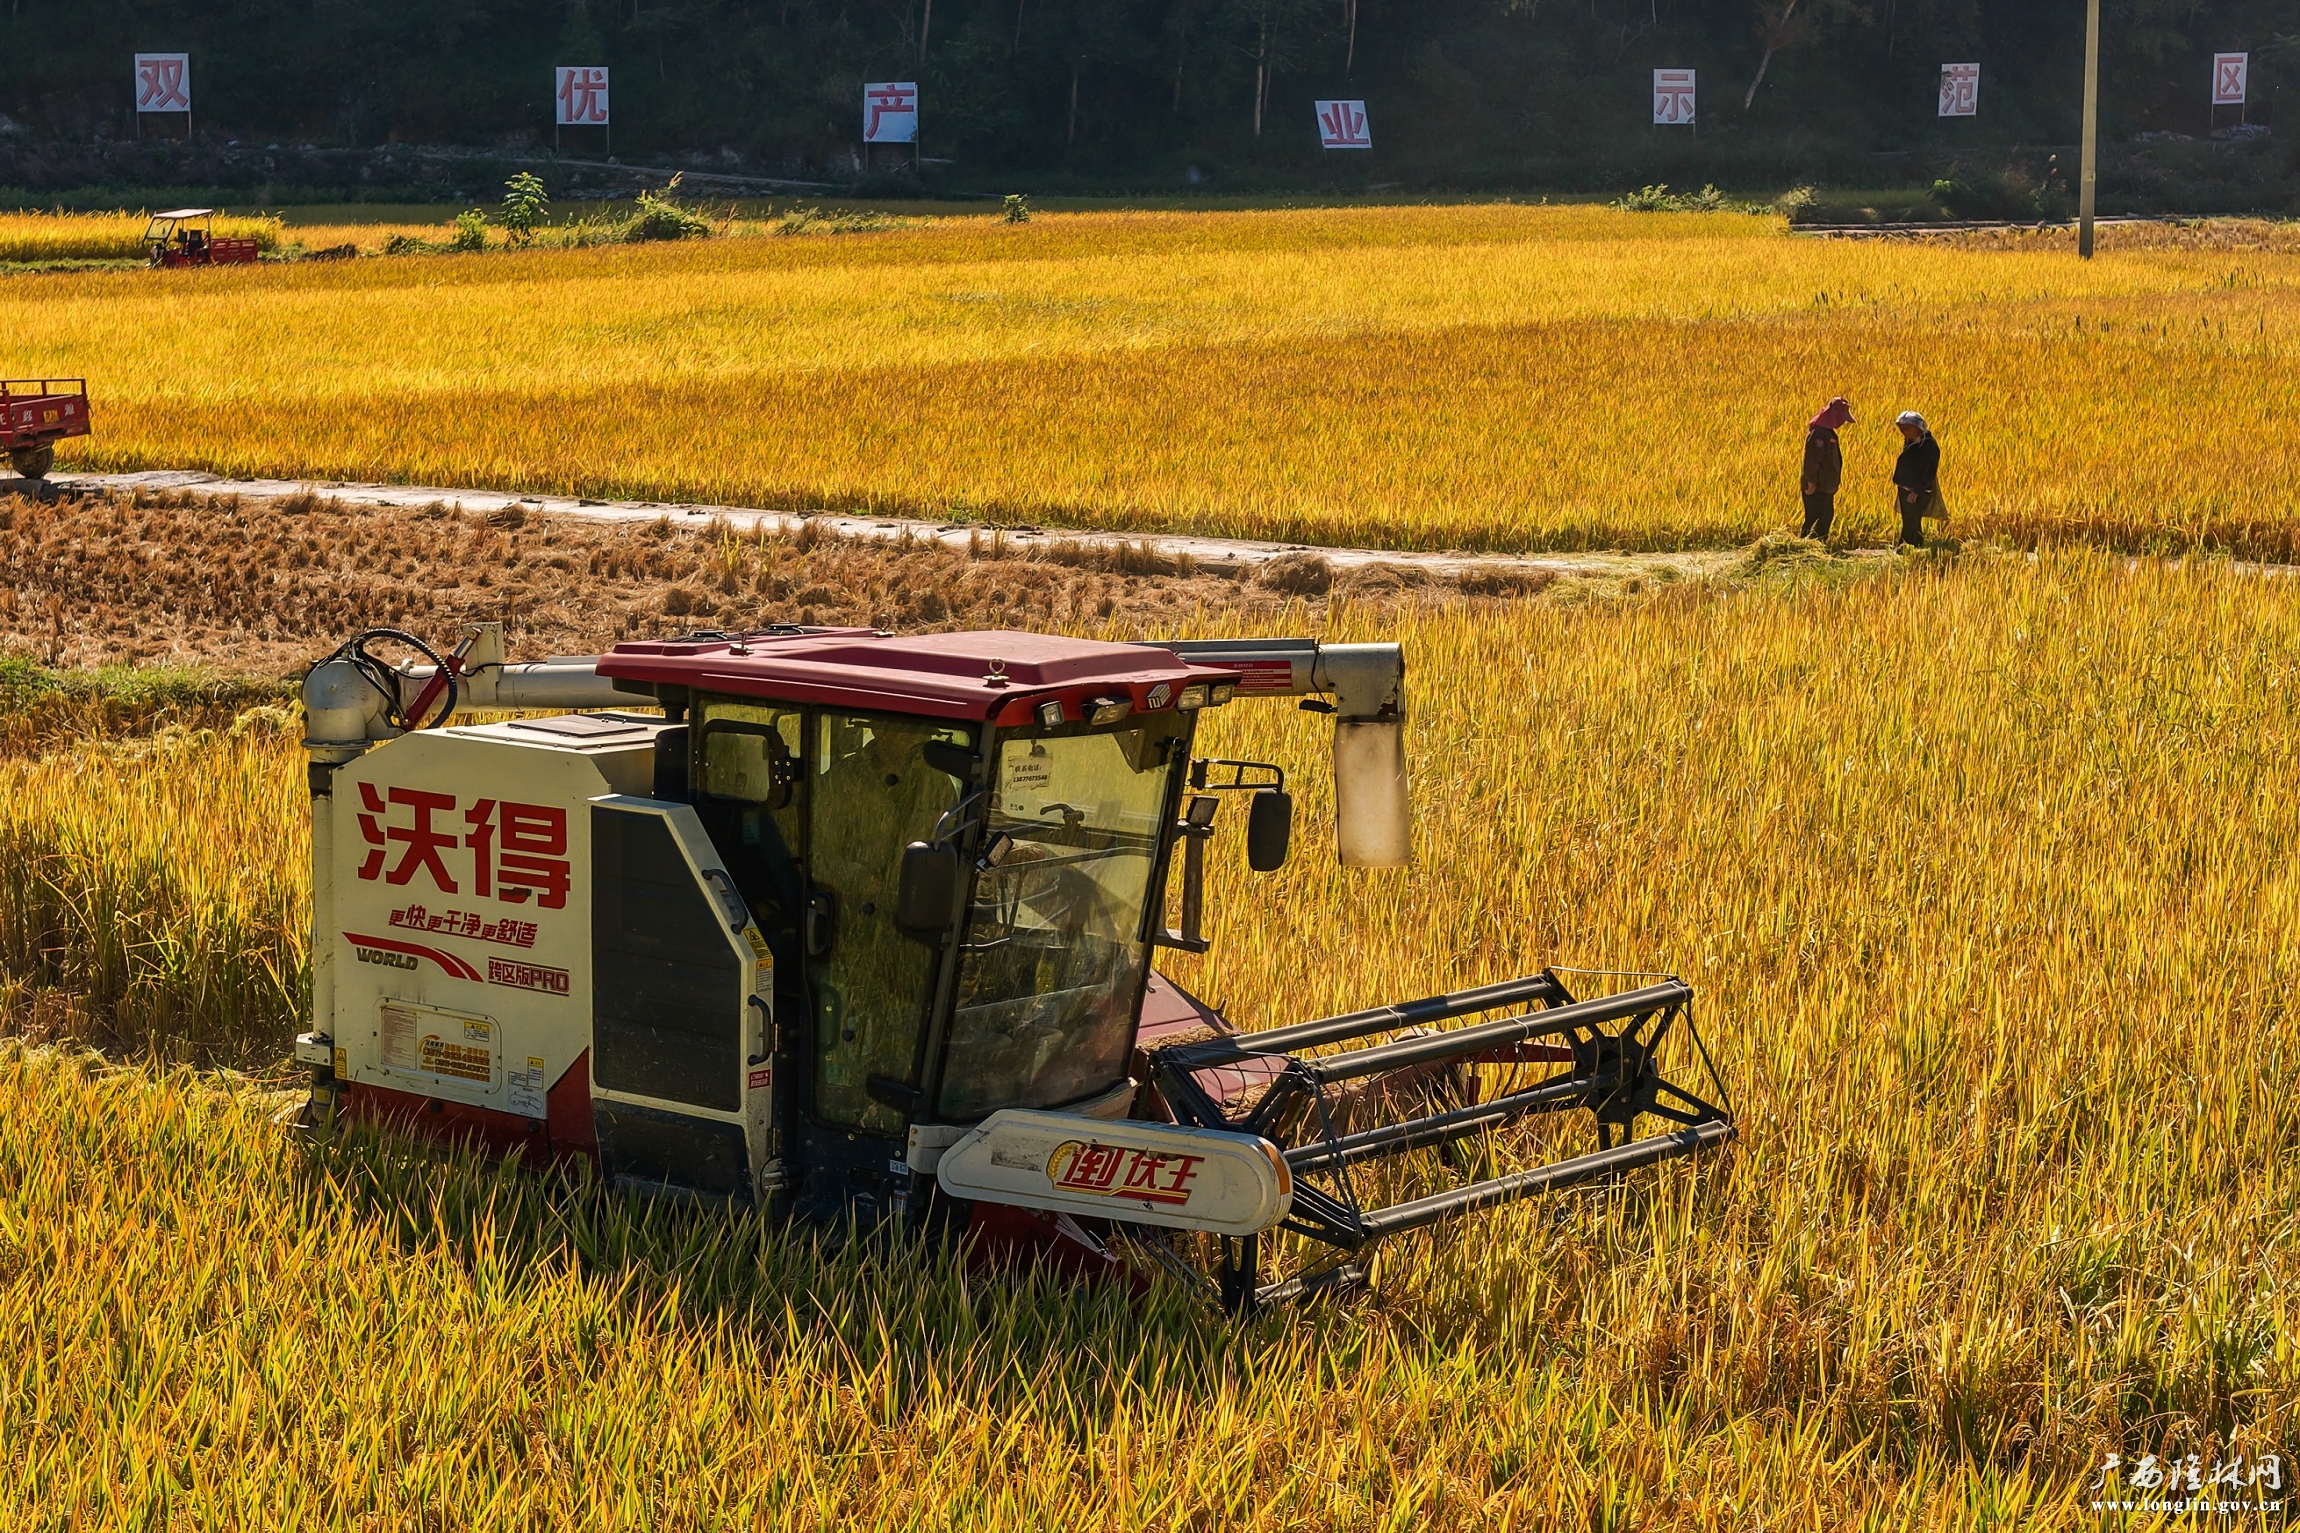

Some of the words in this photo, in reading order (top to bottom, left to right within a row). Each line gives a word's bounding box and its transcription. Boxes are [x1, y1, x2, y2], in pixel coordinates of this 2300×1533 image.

[137, 59, 188, 108] 双
[559, 69, 607, 122] 优
[1655, 73, 1694, 122] 示
[1942, 66, 1977, 113] 范
[2215, 57, 2244, 100] 区
[866, 84, 914, 139] 产
[1320, 102, 1369, 145] 业
[357, 782, 570, 909] 沃得
[389, 904, 537, 943] 更快更干净更舒适
[356, 947, 418, 970] WORLD
[1062, 1144, 1205, 1191] 倒伏王
